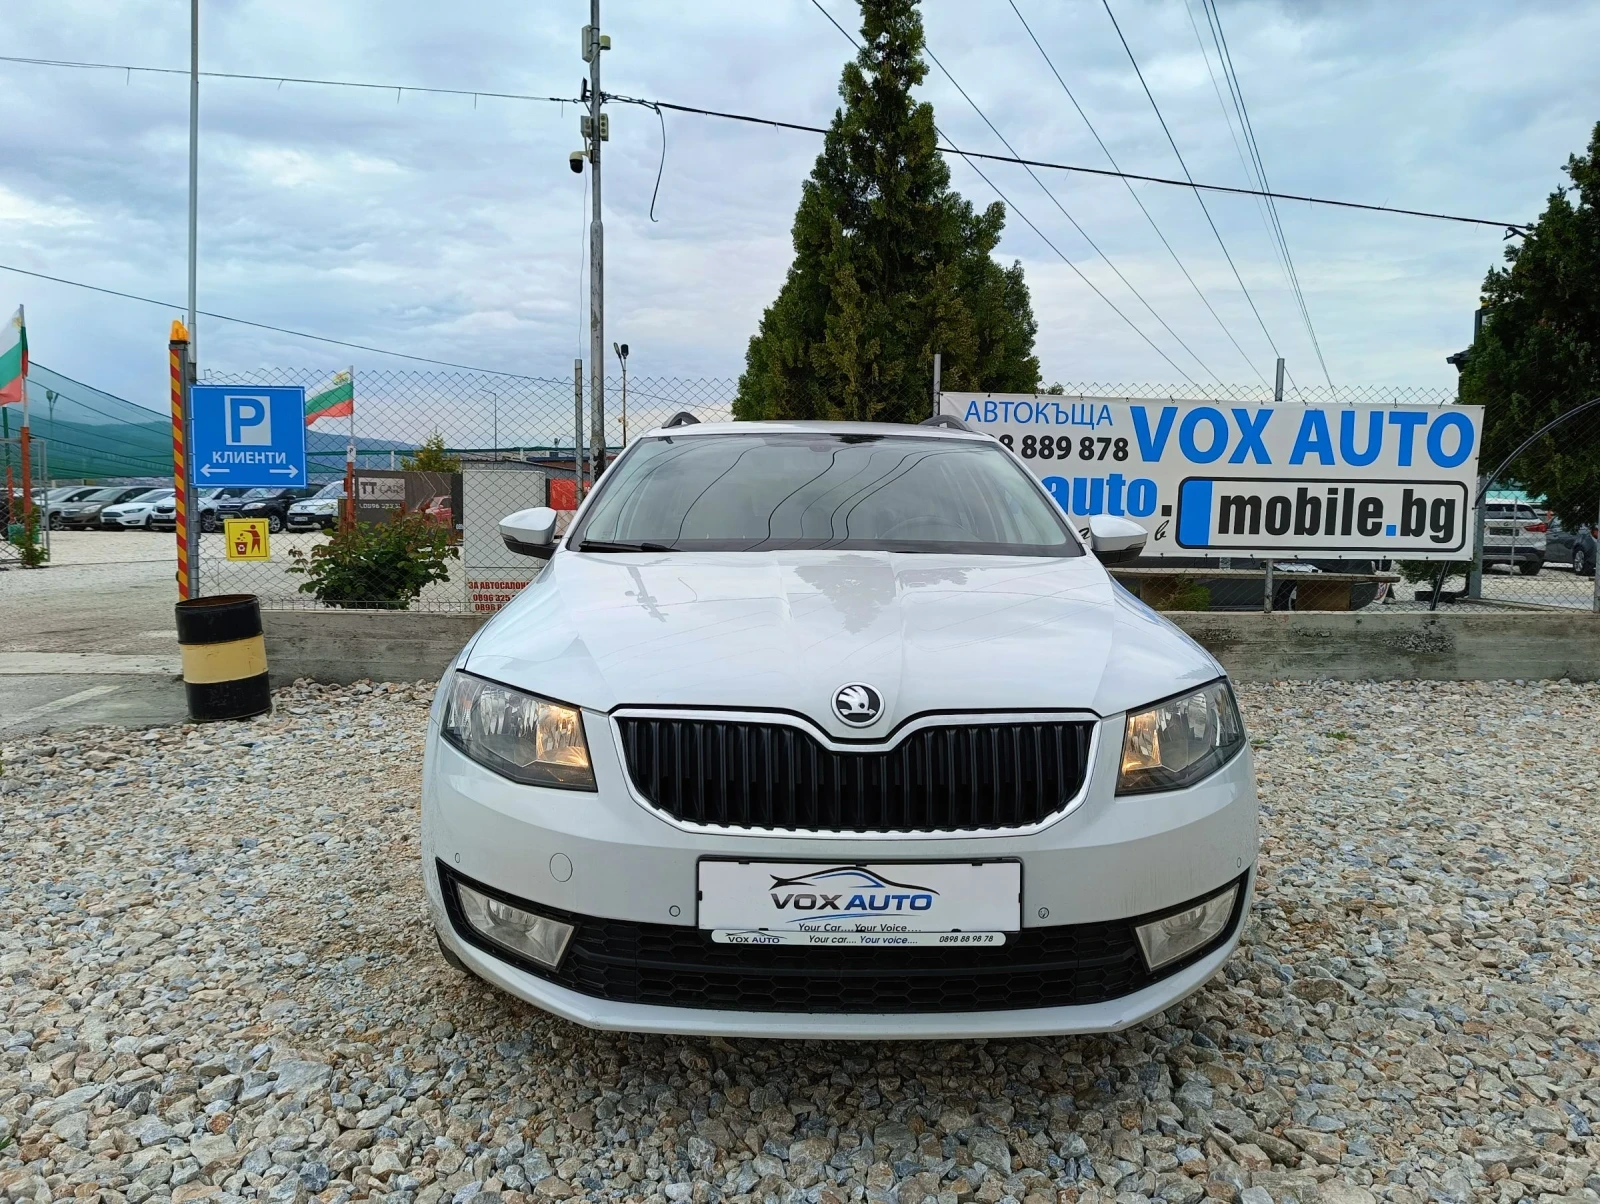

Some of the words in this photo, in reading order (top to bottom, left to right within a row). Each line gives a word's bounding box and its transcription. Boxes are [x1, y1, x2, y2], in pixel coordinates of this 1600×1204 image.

[230, 398, 265, 443] P
[964, 400, 1114, 431] АВТОКЪЩА
[1021, 435, 1072, 460] 889
[1078, 437, 1129, 462] 878
[1129, 406, 1274, 465] VOX
[1288, 409, 1475, 469] AUTO
[212, 451, 287, 464] КЛИЕНТИ
[360, 481, 377, 495] TT
[1217, 487, 1456, 544] mobile.bg
[771, 893, 843, 910] VOX
[844, 894, 933, 911] AUTO
[799, 923, 821, 932] Your
[752, 936, 780, 944] AUTO
[809, 935, 830, 943] Your
[860, 935, 881, 944] Your
[939, 935, 959, 943] 0898
[984, 935, 994, 943] 78
